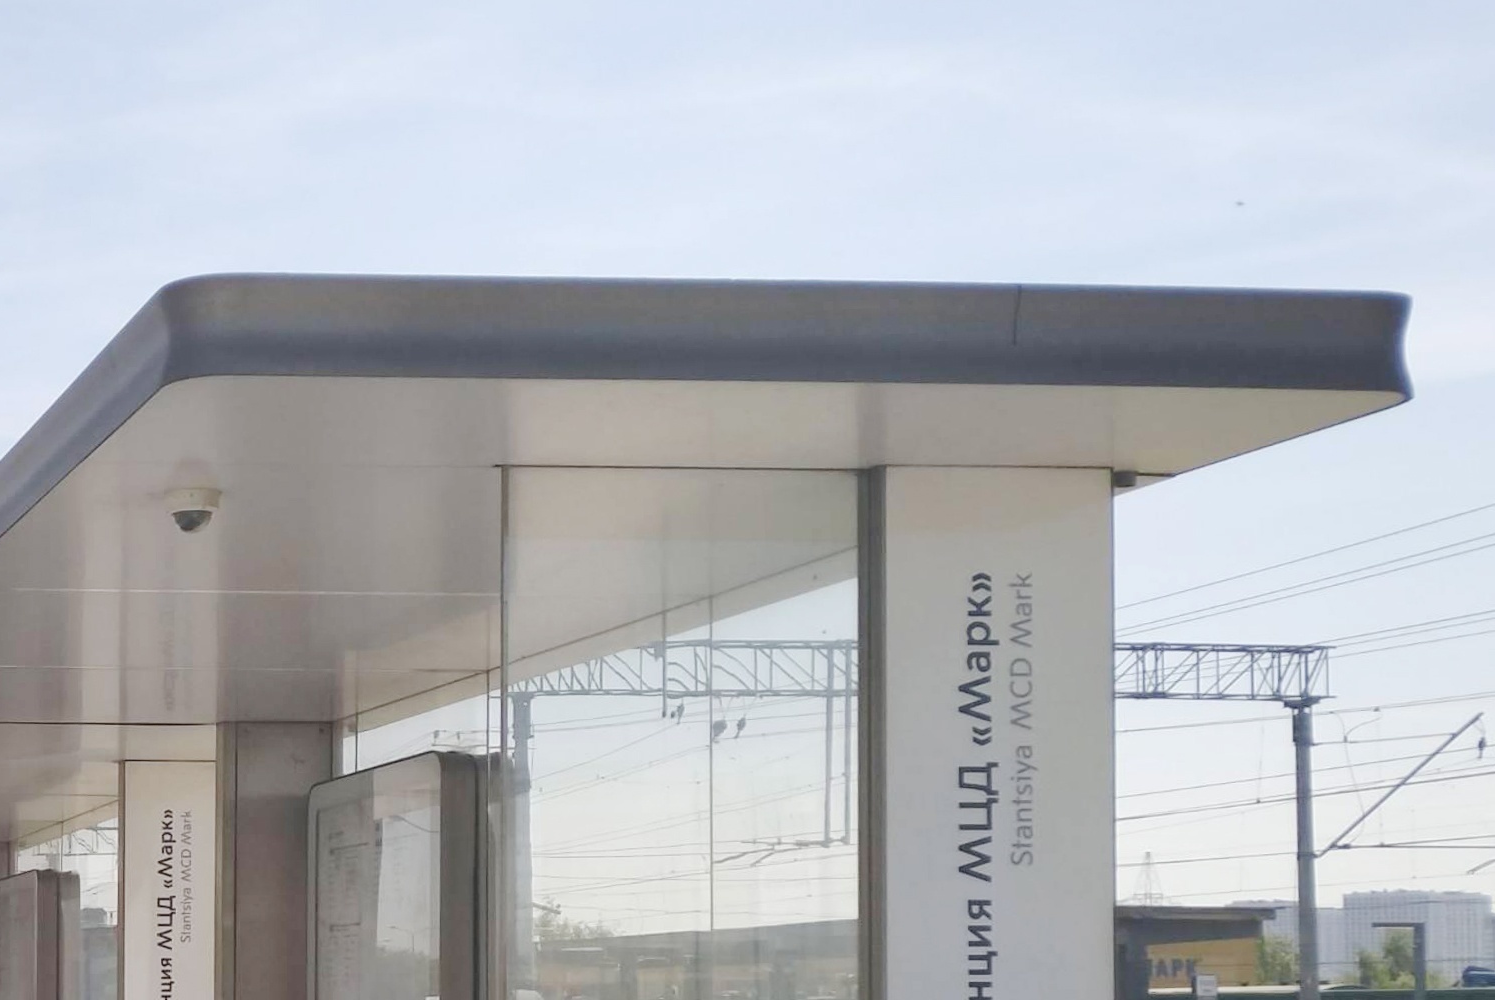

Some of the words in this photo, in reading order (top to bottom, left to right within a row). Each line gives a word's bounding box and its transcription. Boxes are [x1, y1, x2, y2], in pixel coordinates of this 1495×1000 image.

[1009, 573, 1032, 647] Mark
[958, 572, 1000, 746] «Марк»
[1010, 658, 1032, 730] MCD
[180, 811, 192, 845] Mark
[958, 762, 999, 883] МЦД
[1010, 745, 1038, 866] Stantsiya
[157, 809, 176, 889] «Марк»
[180, 849, 192, 882] MCD
[157, 895, 176, 950] МЦД
[180, 887, 194, 943] Stantsiya
